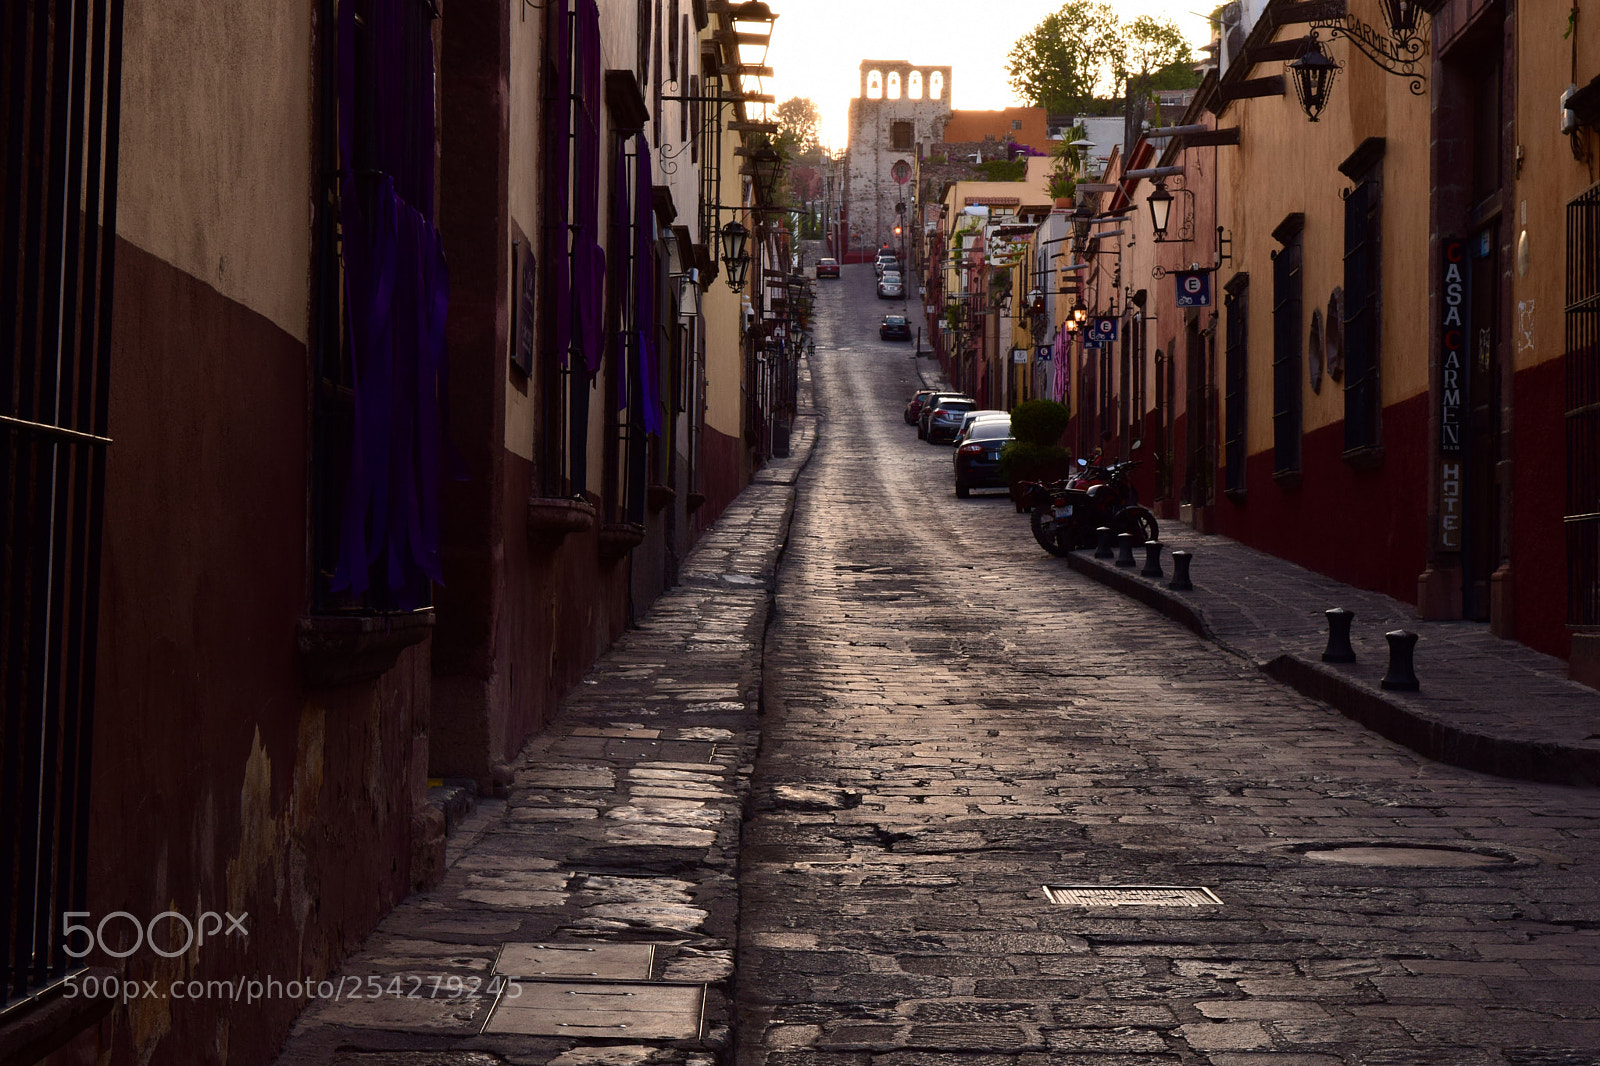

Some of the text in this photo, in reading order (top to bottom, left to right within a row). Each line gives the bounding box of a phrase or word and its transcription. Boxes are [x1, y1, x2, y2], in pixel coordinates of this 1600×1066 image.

[1346, 14, 1399, 59] CARMEN
[1189, 279, 1197, 290] E
[1443, 243, 1462, 444] CASA CARMEN
[1443, 463, 1459, 546] HOTEL
